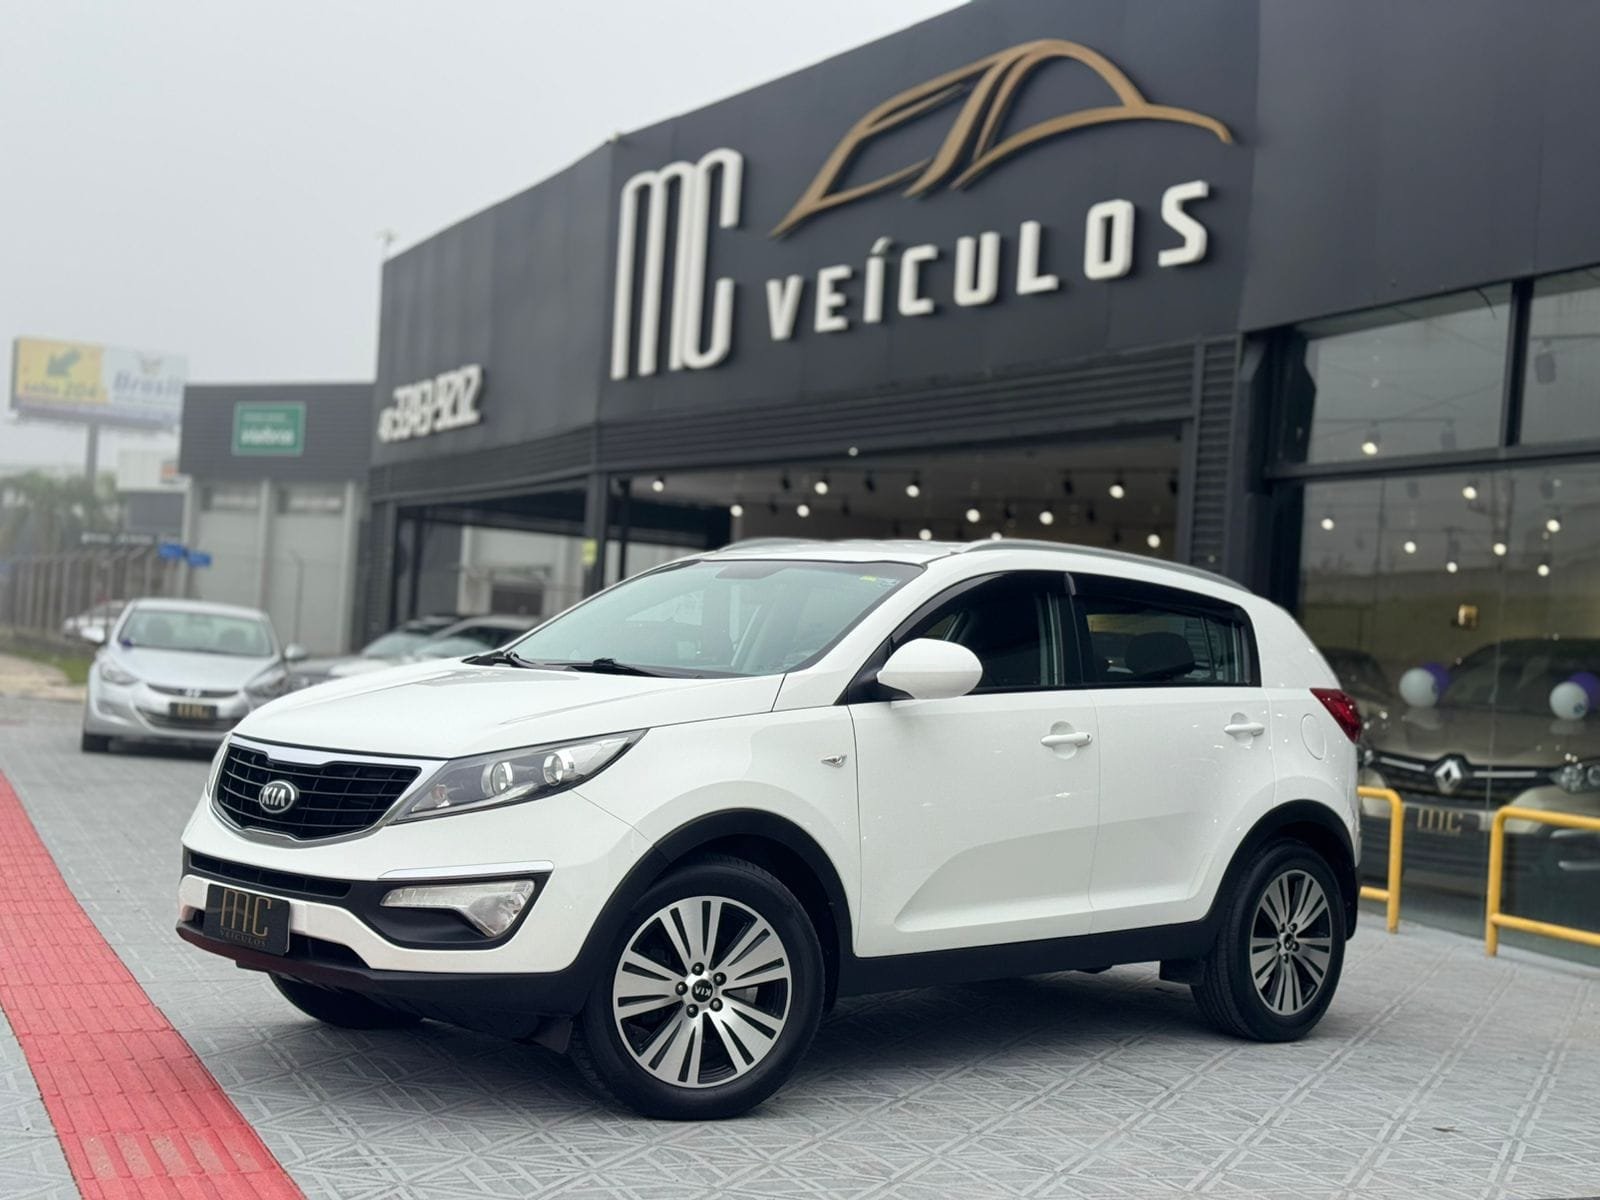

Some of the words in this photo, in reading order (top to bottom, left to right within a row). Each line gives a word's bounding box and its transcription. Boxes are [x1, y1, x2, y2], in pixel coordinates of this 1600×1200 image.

[766, 180, 1210, 341] VEÍCULOS
[262, 786, 286, 807] KIA
[220, 887, 272, 937] MC
